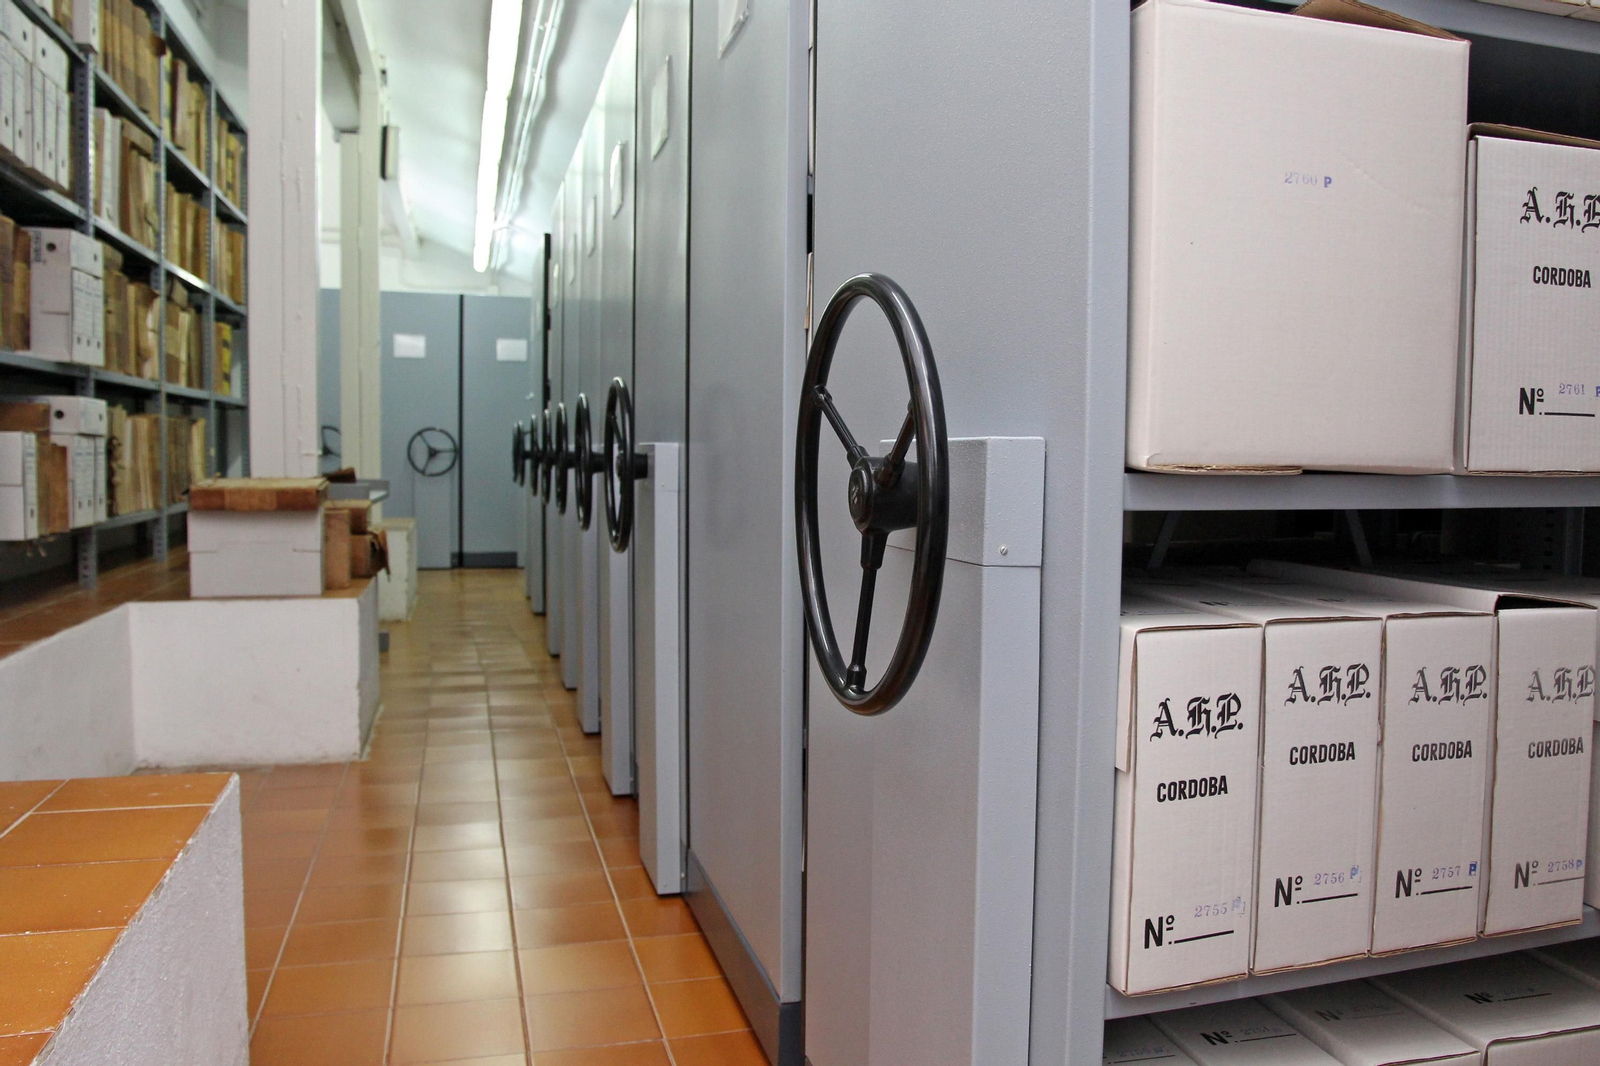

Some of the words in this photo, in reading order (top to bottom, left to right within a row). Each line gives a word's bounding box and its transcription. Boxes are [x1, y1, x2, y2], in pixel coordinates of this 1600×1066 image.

[1533, 265, 1591, 288] CORDOBA
[1559, 383, 1585, 395] 2761
[1290, 741, 1355, 766] CORDOBA
[1412, 740, 1472, 762] CORDOBA
[1528, 736, 1584, 759] CORDOBA
[1157, 775, 1228, 803] CORDOBA
[1432, 866, 1461, 880] 2757
[1547, 859, 1574, 873] 2758
[1314, 872, 1345, 886] 2756
[1194, 902, 1228, 918] 2755
